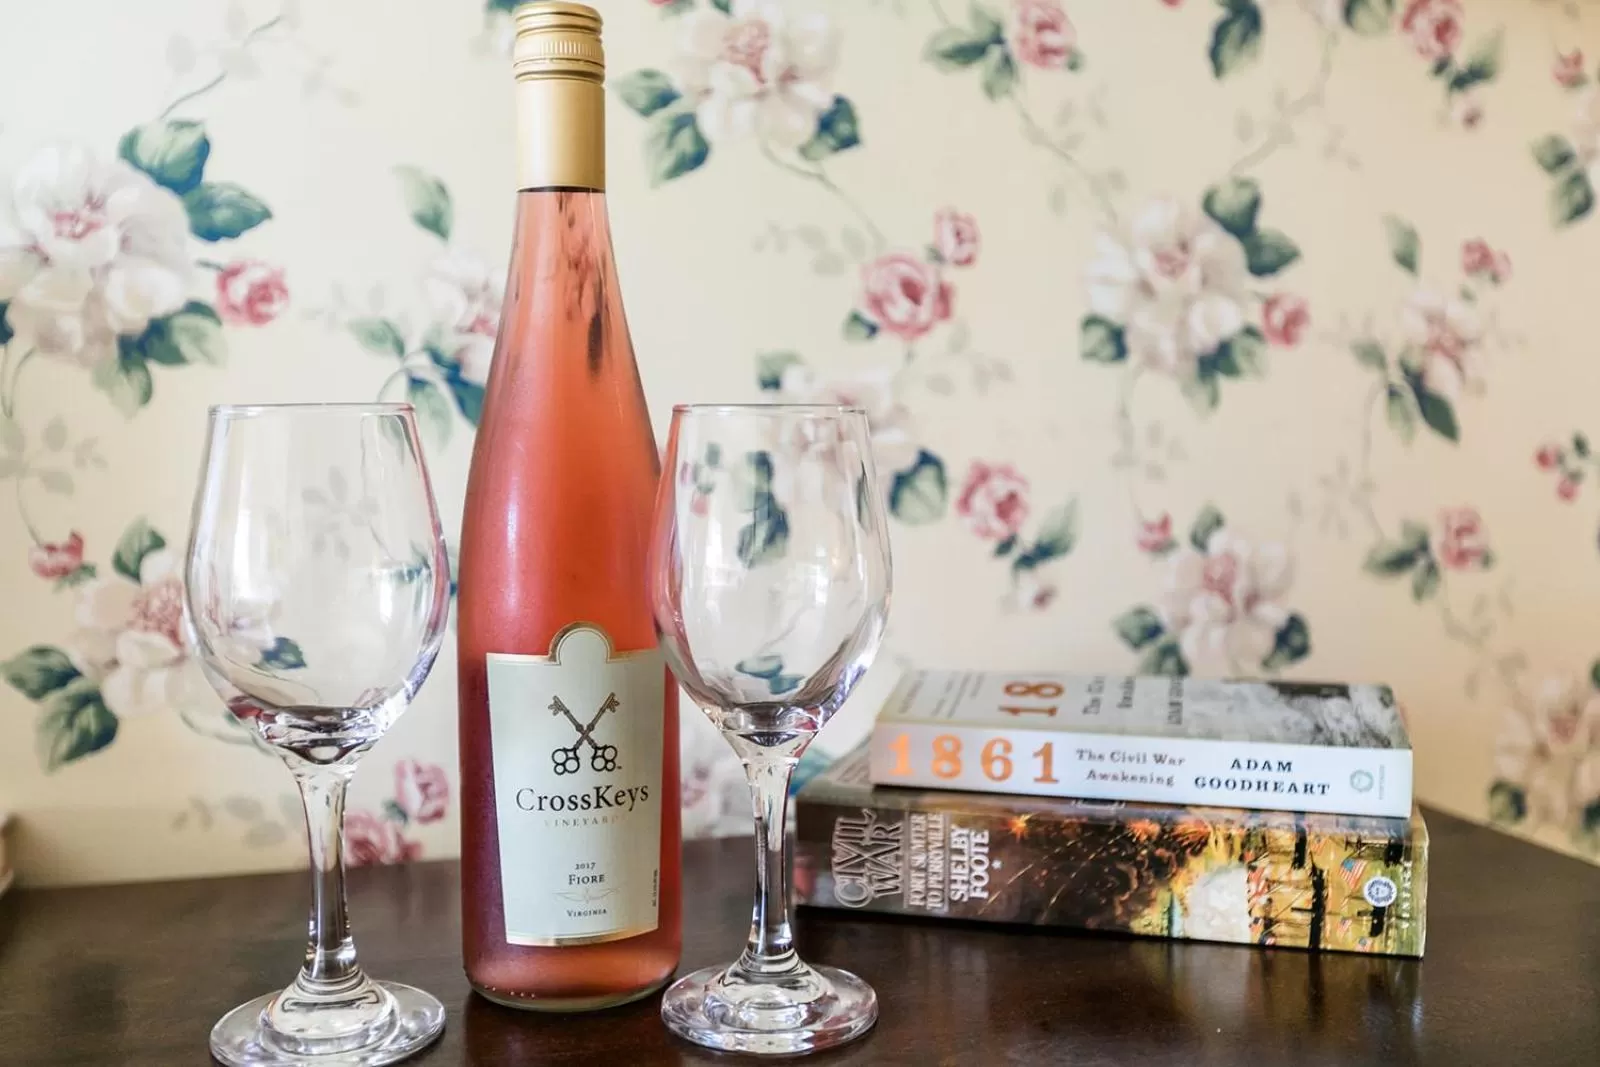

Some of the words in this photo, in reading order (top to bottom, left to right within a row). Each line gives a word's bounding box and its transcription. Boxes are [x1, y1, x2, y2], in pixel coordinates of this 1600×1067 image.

[887, 733, 1060, 784] 1861
[1075, 748, 1105, 763] The
[1109, 751, 1148, 764] Civil
[1152, 753, 1186, 767] War
[1230, 757, 1294, 773] ADAM
[1086, 769, 1176, 787] Awakening
[1194, 775, 1331, 796] GOODHEART
[516, 785, 650, 812] CrossKeys
[909, 813, 927, 868] SUMTER
[926, 812, 945, 889] PERRYVILLE
[575, 862, 596, 870] 2017
[831, 808, 878, 908] CIVIL
[864, 820, 903, 899] WAR
[950, 824, 970, 902] SHELBY
[970, 829, 990, 900] FOOTE
[568, 874, 605, 885] FIORE
[909, 869, 927, 906] FORT
[566, 908, 608, 918] VIRGINIA
[926, 890, 944, 910] TO
